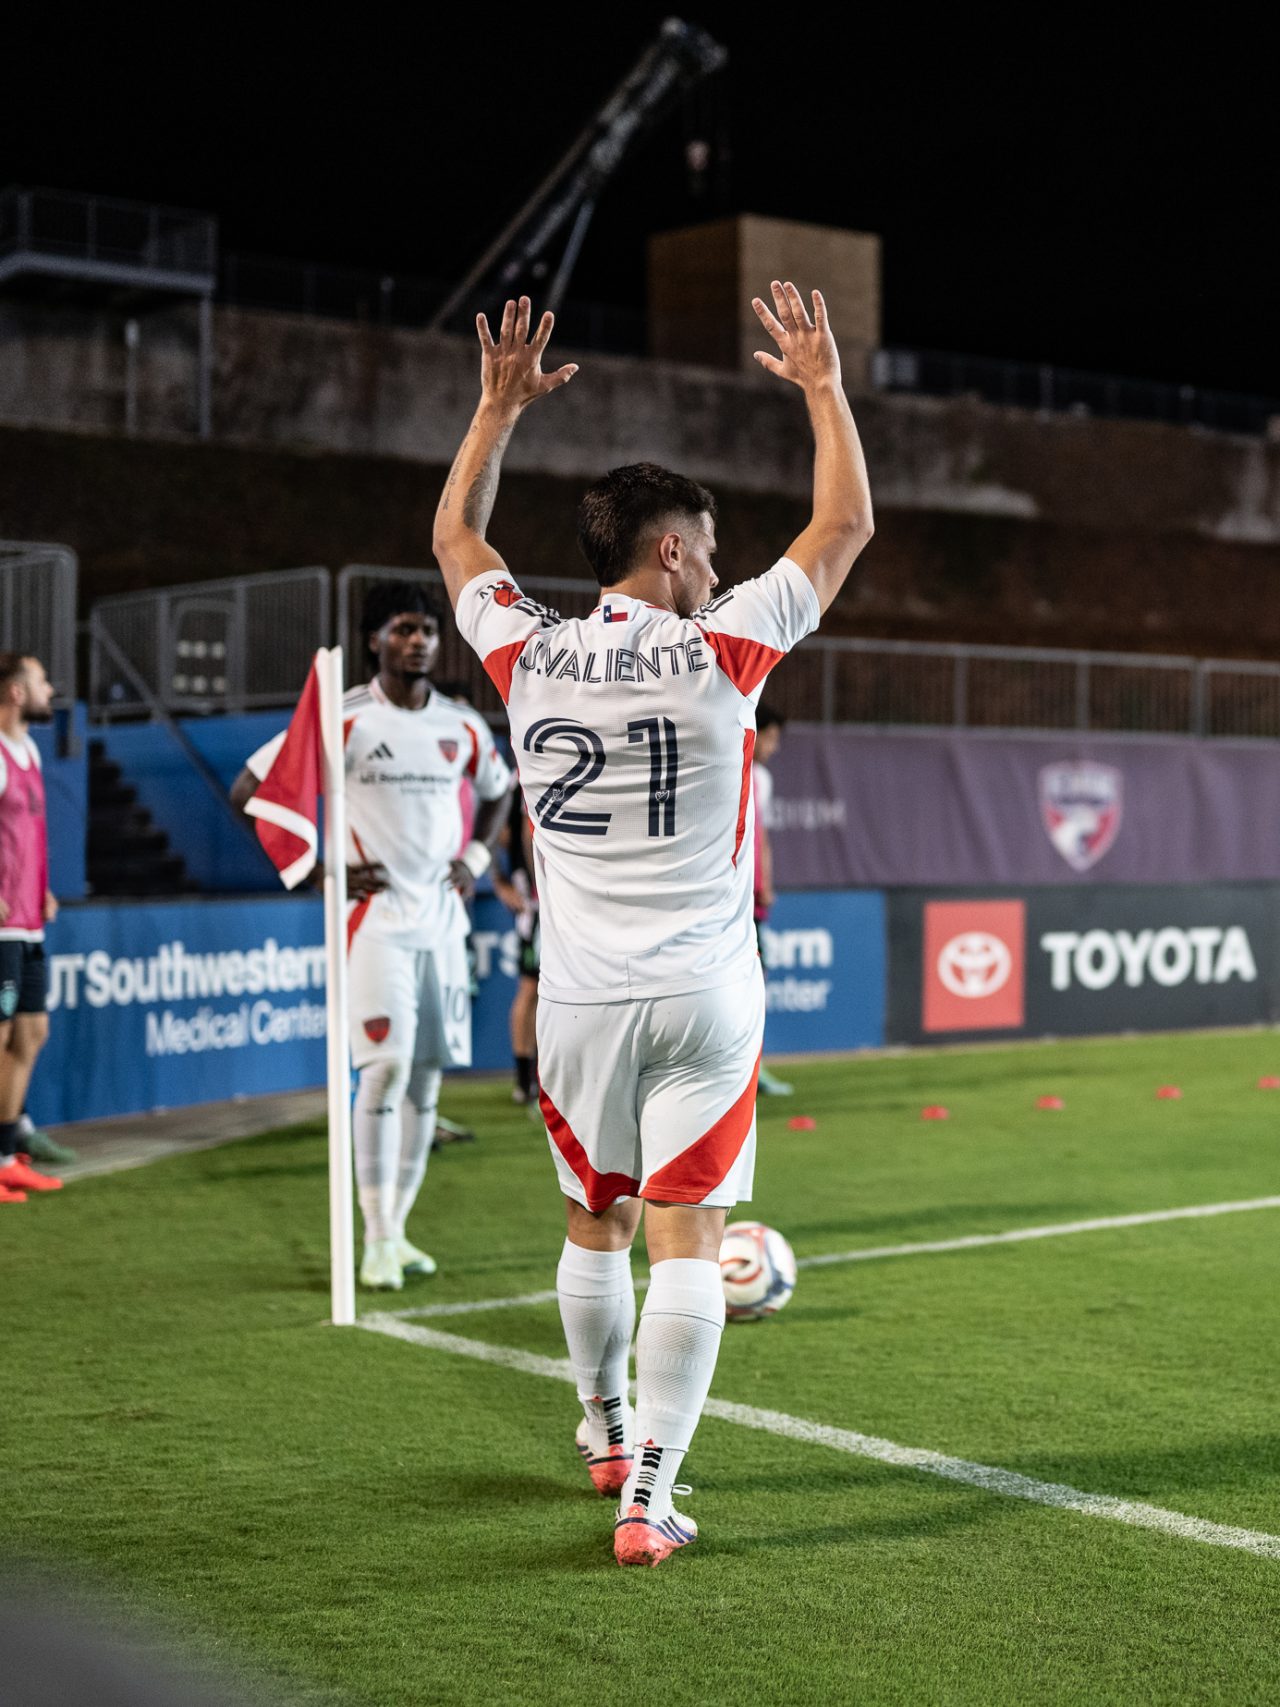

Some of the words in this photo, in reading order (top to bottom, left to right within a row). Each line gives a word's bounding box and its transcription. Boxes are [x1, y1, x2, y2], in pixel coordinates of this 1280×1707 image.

[519, 637, 709, 683] J.VALIENTE
[523, 716, 678, 837] 21
[1040, 926, 1258, 991] TOYOTA
[146, 1003, 248, 1056] Medical
